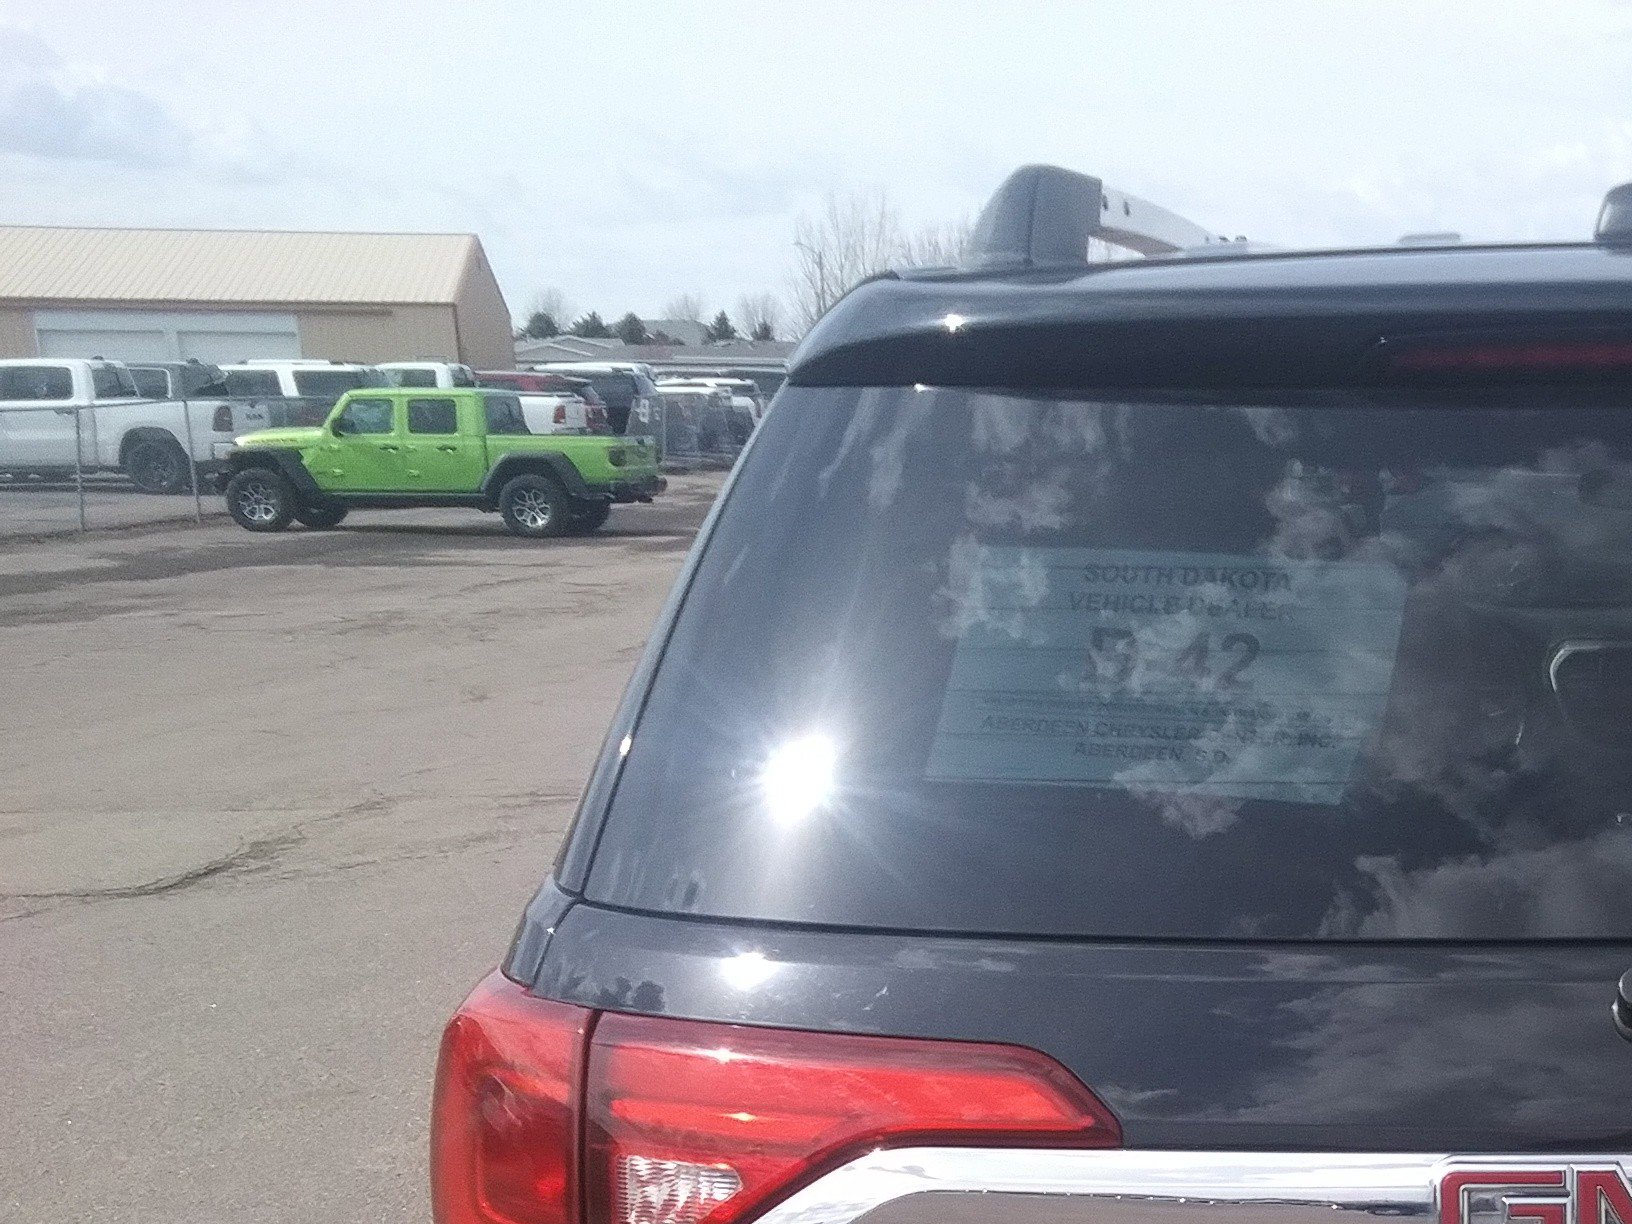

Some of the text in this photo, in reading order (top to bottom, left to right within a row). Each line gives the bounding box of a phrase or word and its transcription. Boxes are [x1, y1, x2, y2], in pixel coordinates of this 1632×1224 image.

[1083, 564, 1293, 591] SOUTH DAKOTA
[1069, 591, 1179, 615] VEHICLE
